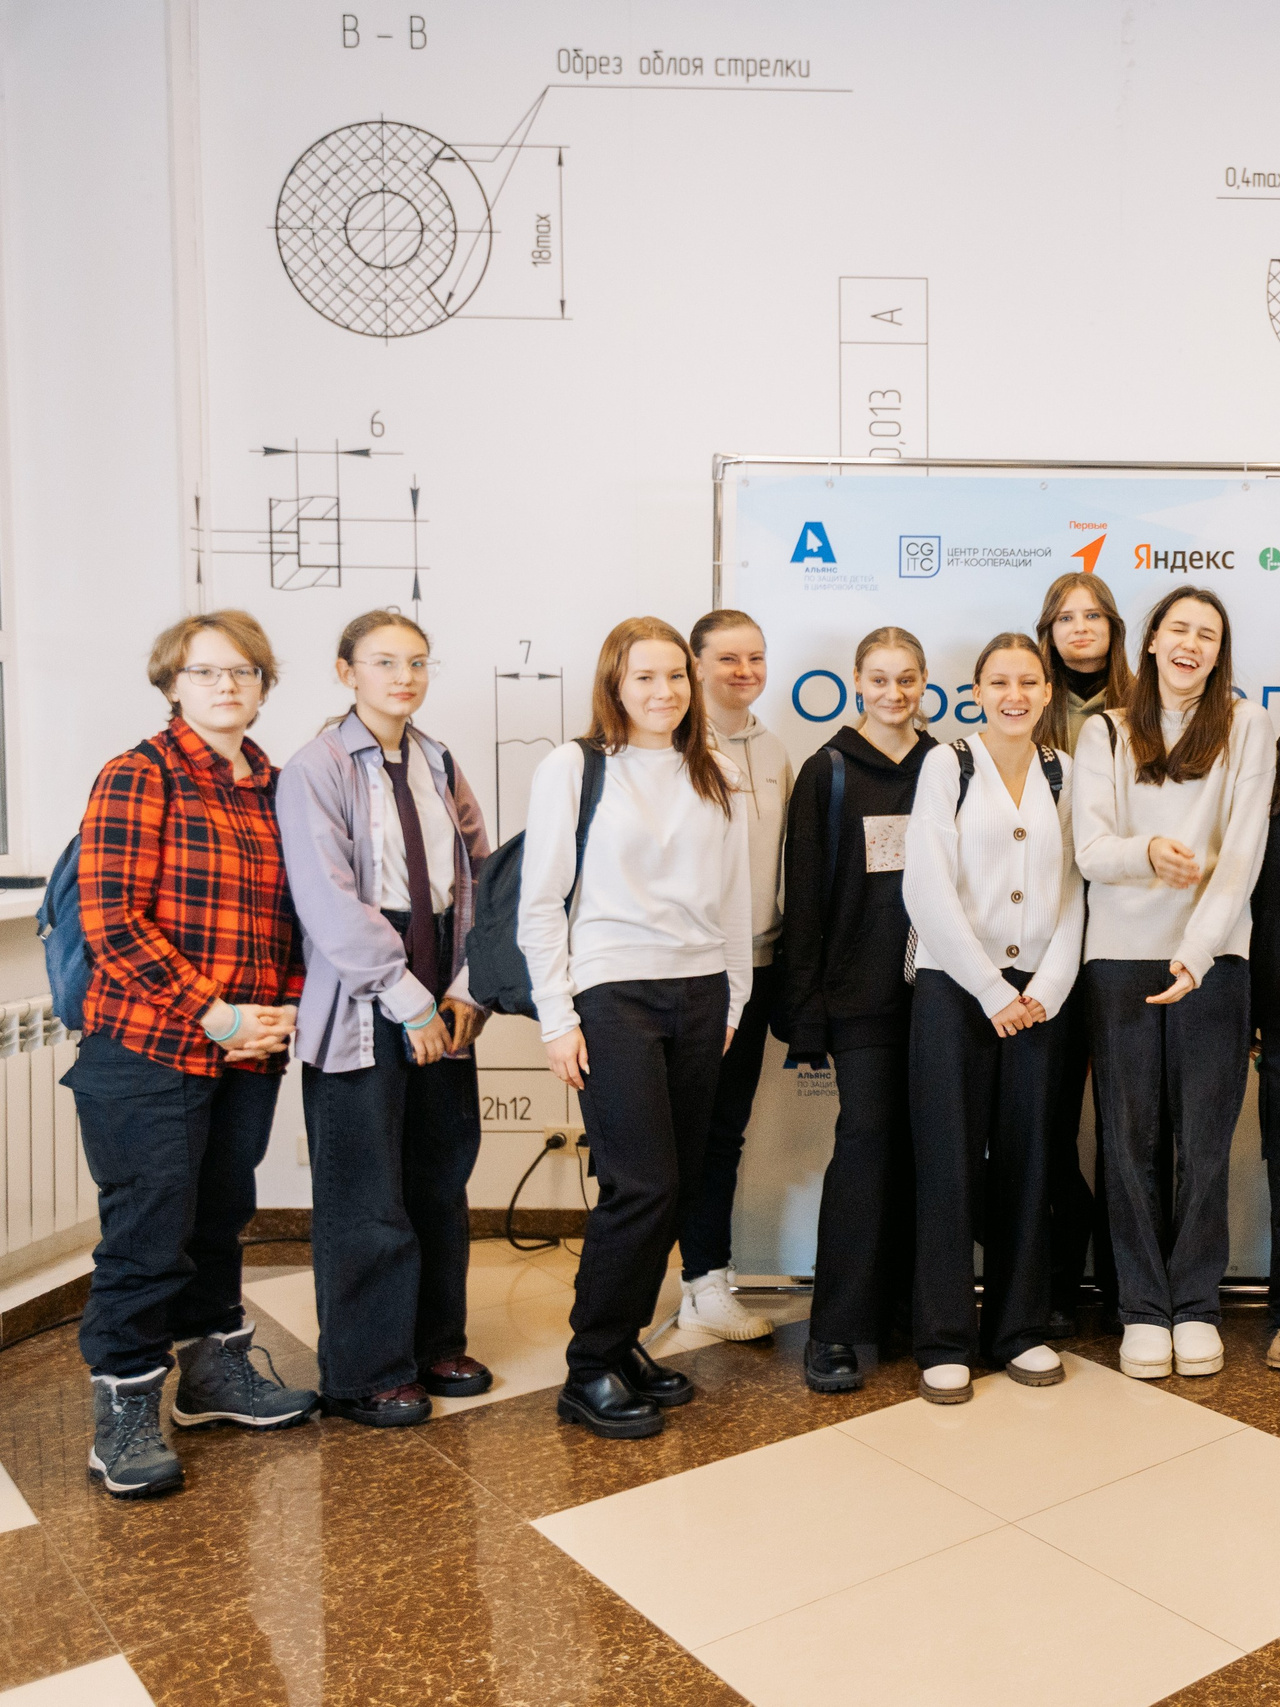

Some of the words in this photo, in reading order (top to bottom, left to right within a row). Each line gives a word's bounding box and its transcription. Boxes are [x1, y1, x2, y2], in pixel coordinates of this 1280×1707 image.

[557, 48, 623, 80] Обрез
[639, 50, 703, 76] облоя
[714, 56, 810, 83] стрелки
[531, 213, 552, 268] 18max
[370, 410, 385, 438] 6
[1069, 520, 1108, 532] Первые
[905, 542, 934, 557] CG
[947, 547, 979, 557] ЦЕНТР
[982, 546, 1052, 558] ГЛОБАЛЬНОЙ
[1134, 544, 1235, 573] Яндекс
[804, 566, 838, 574] АЛЬЯНС
[906, 557, 934, 572] ITC
[947, 558, 1032, 568] ИТ-КООПЕРАЦИИ
[519, 639, 532, 665] 7
[482, 1096, 532, 1121] 2h12
